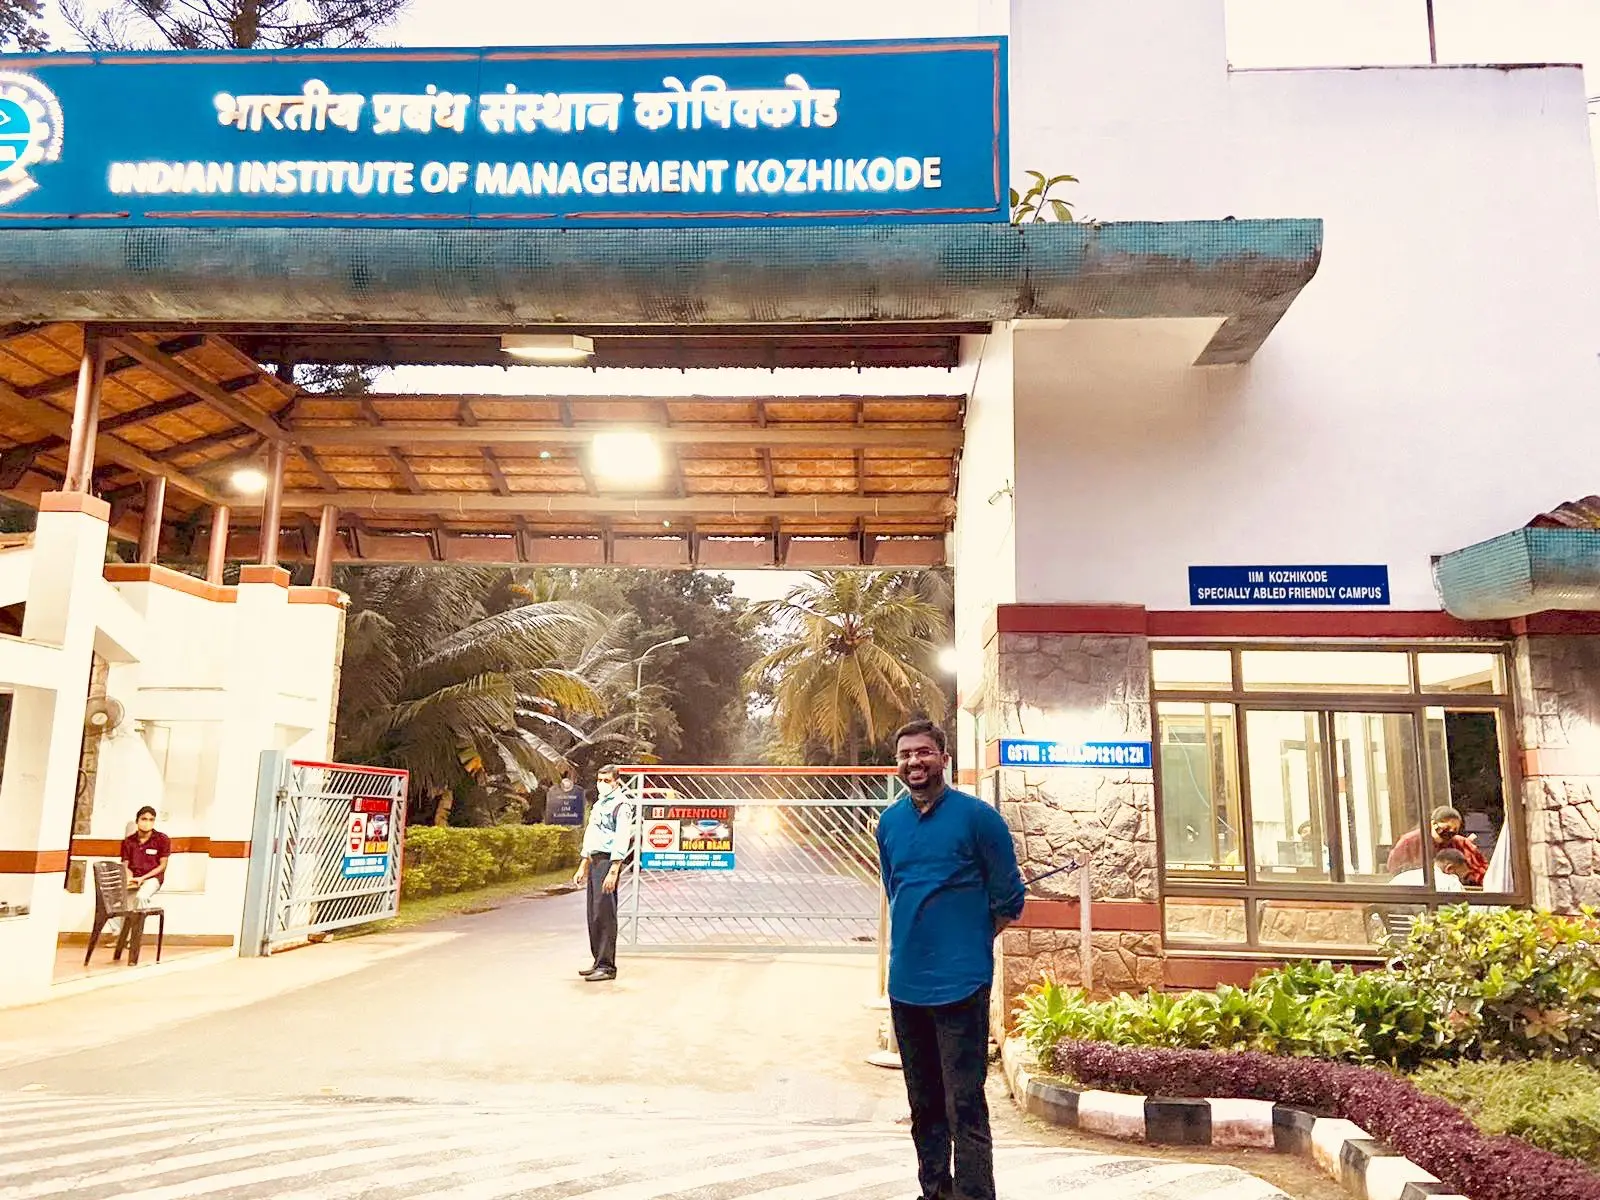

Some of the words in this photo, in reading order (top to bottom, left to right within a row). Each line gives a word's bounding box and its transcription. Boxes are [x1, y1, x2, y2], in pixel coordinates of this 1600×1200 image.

[215, 79, 364, 132] भारतीय
[373, 84, 470, 134] प्रबंध
[480, 84, 623, 133] संस्थान
[109, 161, 234, 194] INDIAN
[239, 161, 414, 194] INSTITUTE
[421, 162, 468, 193] OF
[475, 159, 729, 195] MANAGEMENT
[735, 156, 942, 193] KOZHIKODE
[1248, 571, 1264, 583] IIM
[1268, 571, 1328, 583] KOZHIKODE
[1197, 587, 1251, 600] SPECIALLY
[1253, 587, 1286, 599] ABLED
[1288, 587, 1336, 599] FRIENDLY
[1338, 586, 1382, 599] CAMPUS
[667, 806, 728, 818] ATTENTION
[682, 840, 704, 850] HIGH
[706, 840, 731, 850] BEAM
